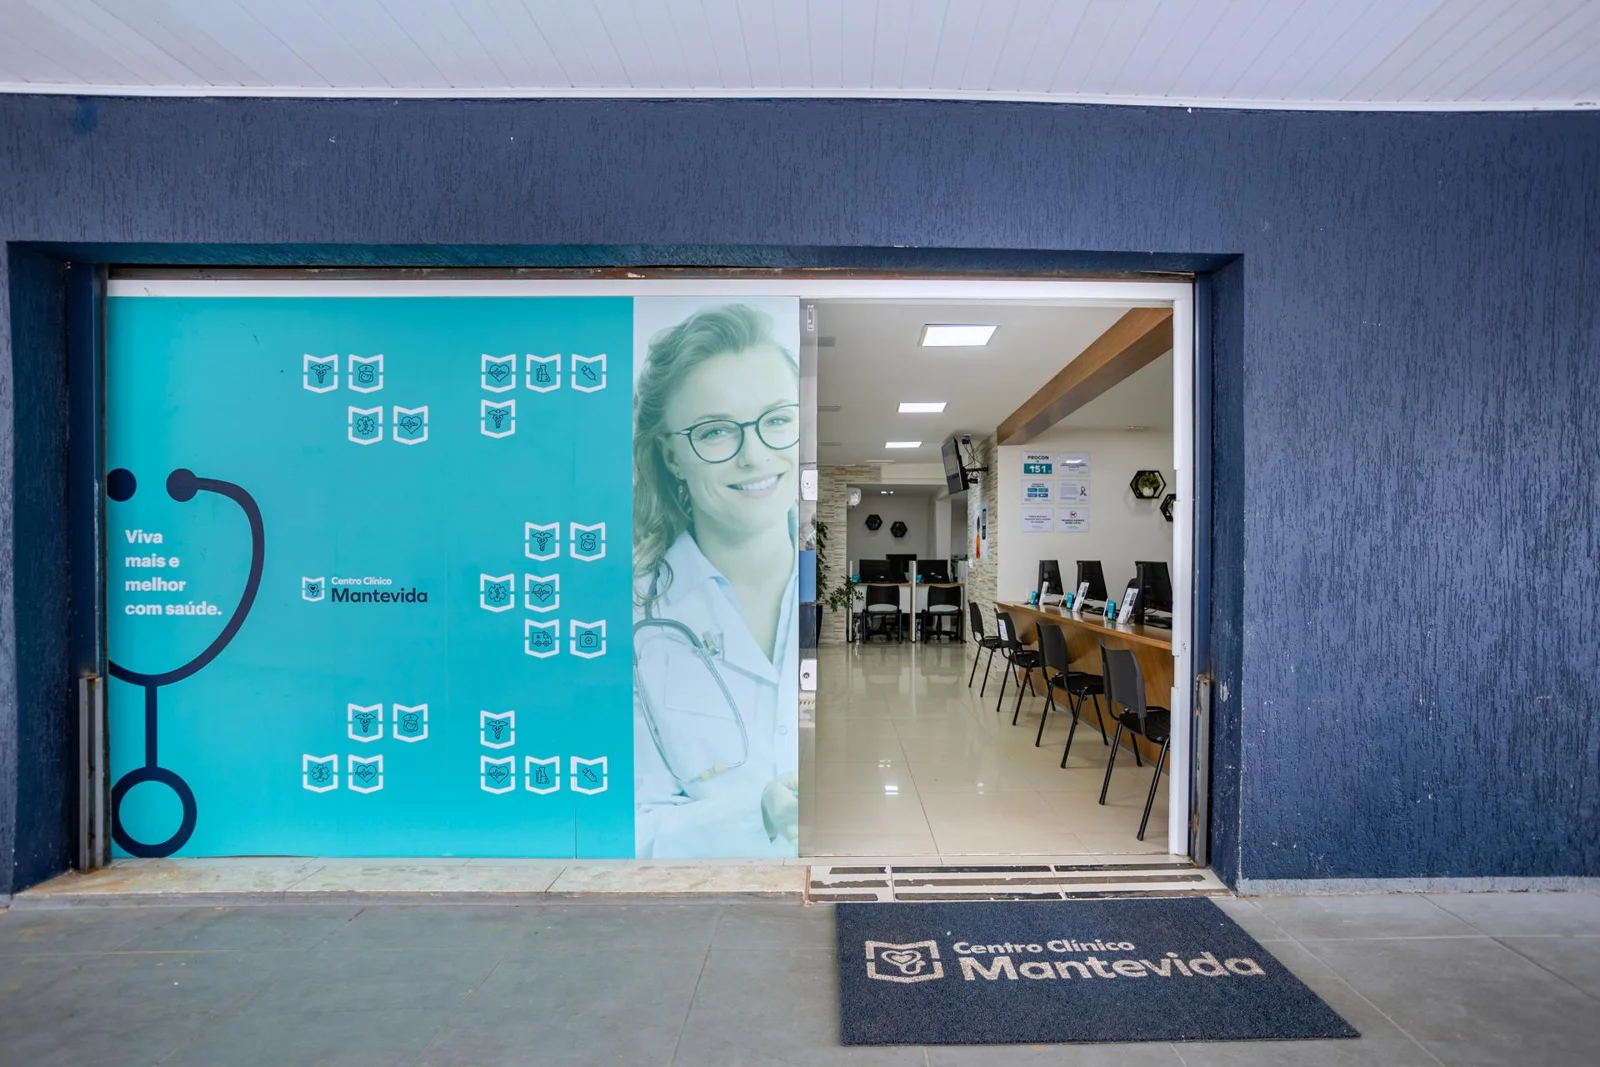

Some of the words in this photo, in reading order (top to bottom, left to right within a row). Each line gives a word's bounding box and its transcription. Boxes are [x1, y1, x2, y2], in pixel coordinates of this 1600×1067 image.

[1029, 465, 1047, 473] 151
[125, 529, 163, 544] Viva
[125, 553, 166, 568] mais
[168, 556, 180, 568] e
[125, 577, 186, 592] melhor
[331, 576, 362, 586] Centro
[363, 576, 392, 586] Clínico
[331, 587, 428, 603] Mantevida
[125, 602, 162, 616] com
[165, 600, 222, 616] saúde.
[952, 940, 1043, 955] Centro
[1046, 938, 1136, 954] Clínico
[959, 951, 1267, 982] Mantevida
